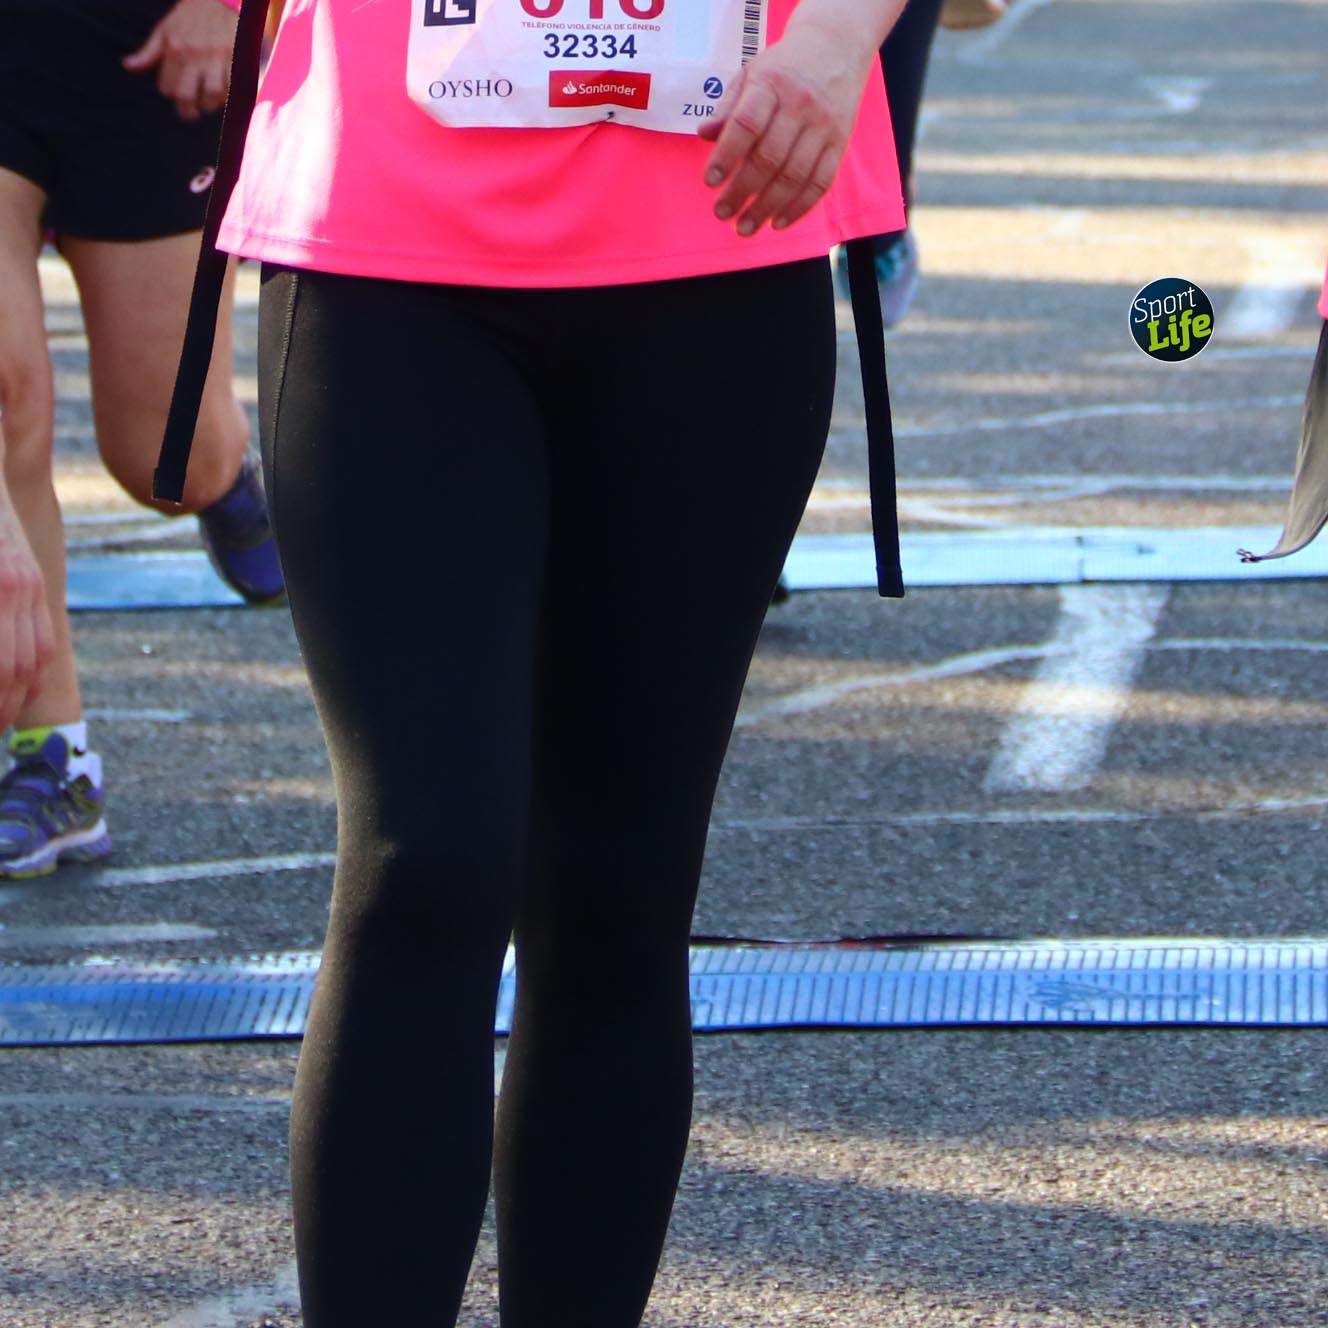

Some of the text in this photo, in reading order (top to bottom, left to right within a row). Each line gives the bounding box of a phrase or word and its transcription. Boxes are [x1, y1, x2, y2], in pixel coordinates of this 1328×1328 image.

[614, 23, 625, 31] DE
[543, 33, 638, 59] 32334
[429, 79, 513, 99] OYSHO
[578, 81, 637, 97] Santander
[683, 103, 715, 117] ZUR
